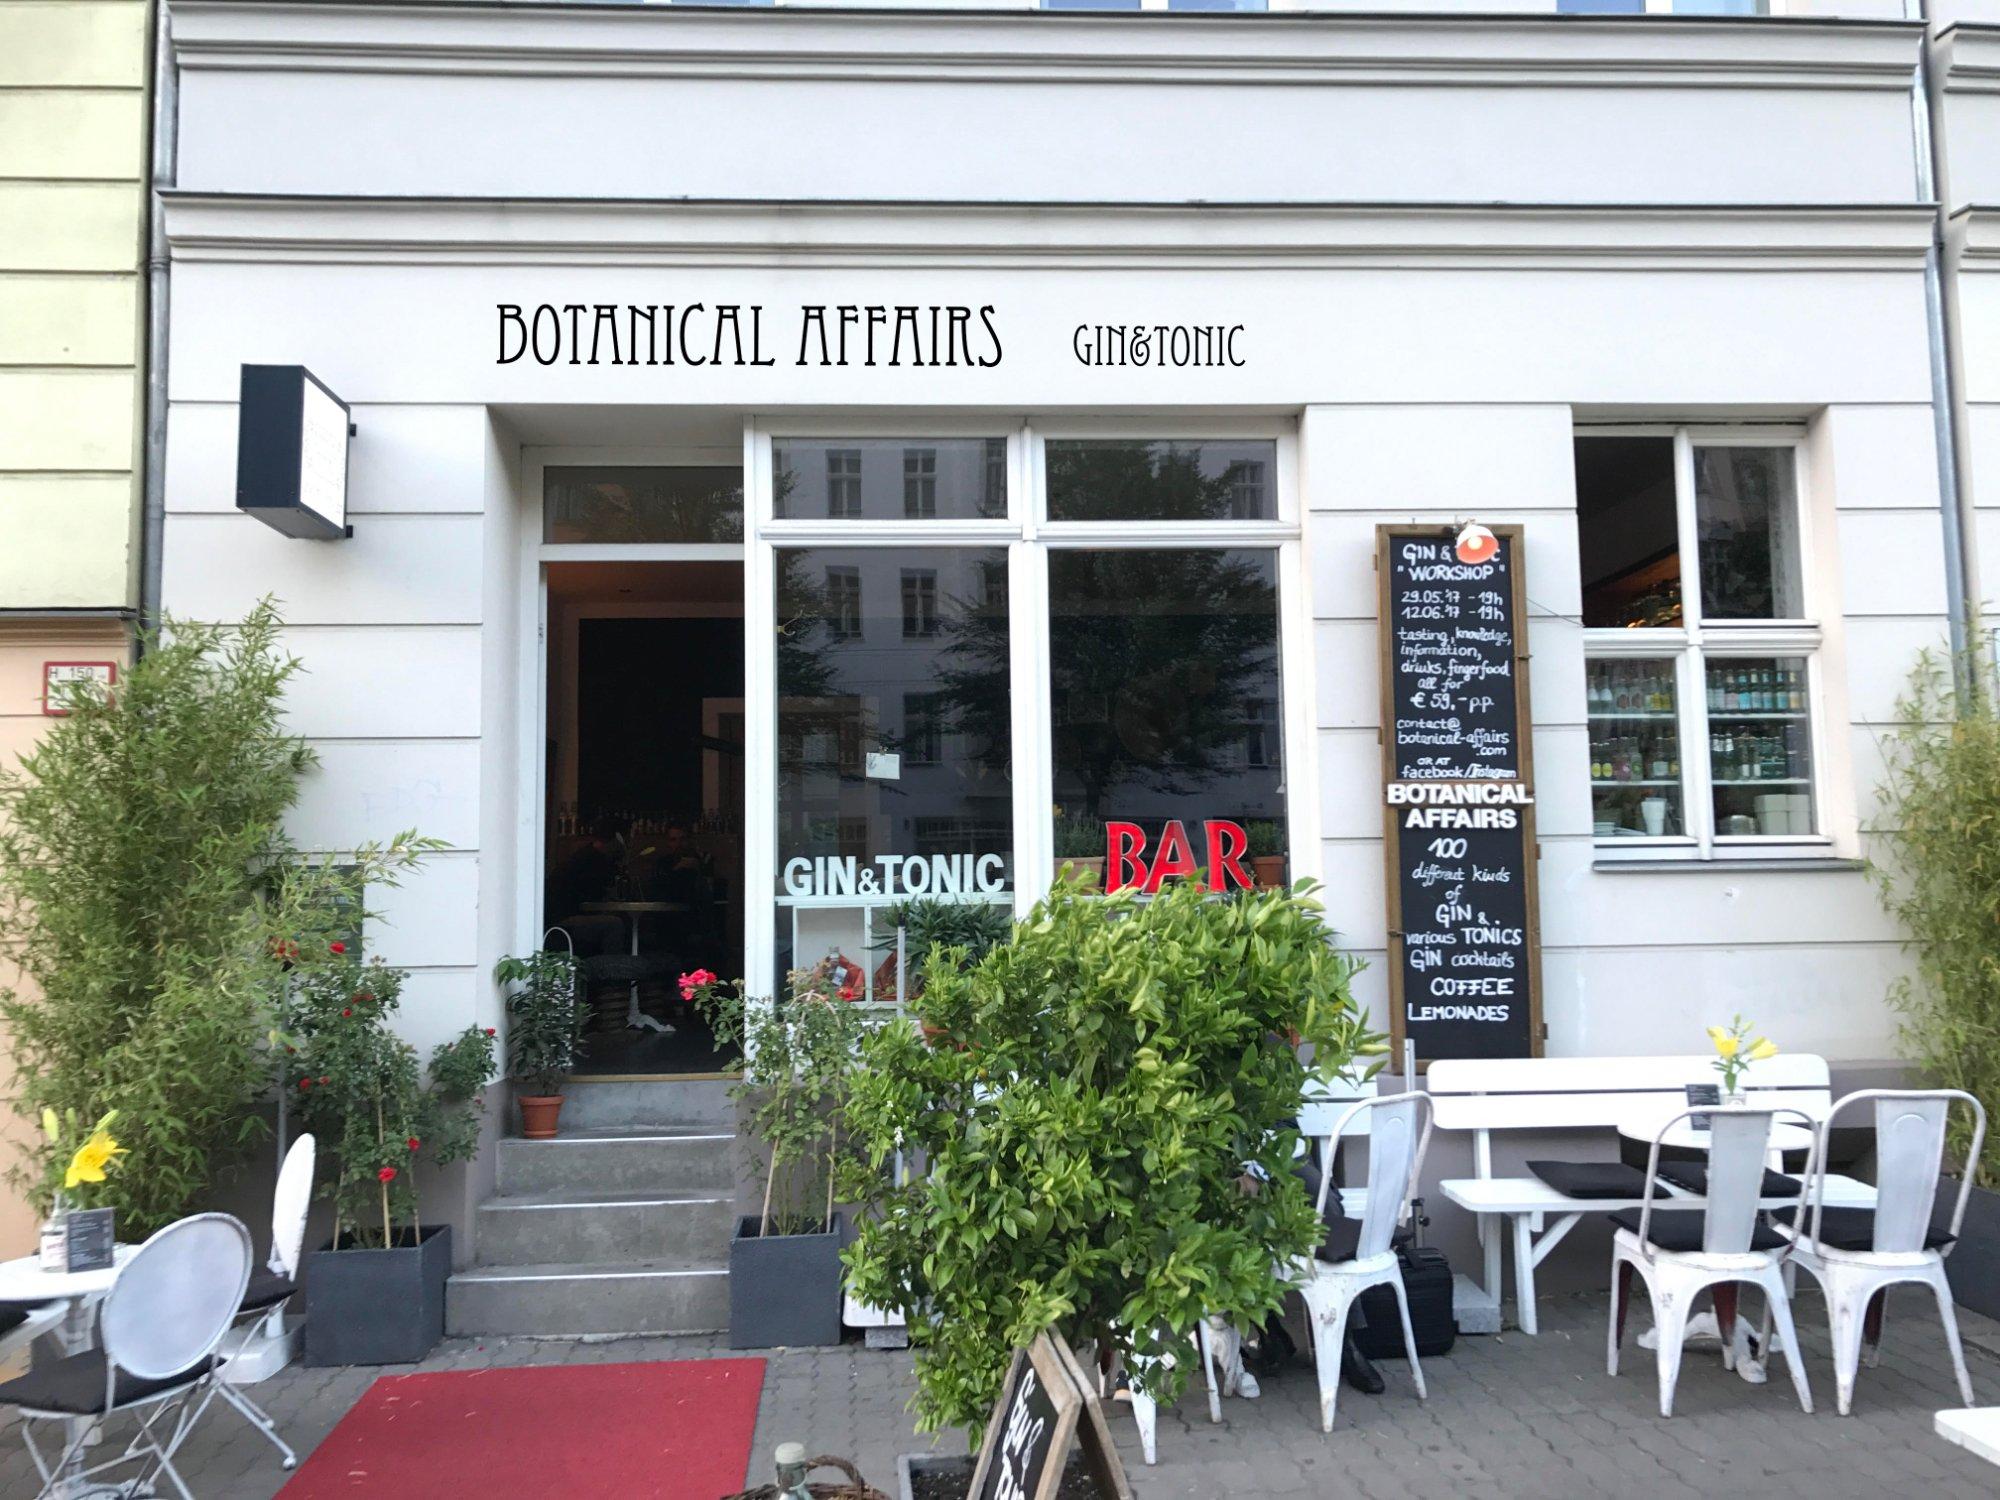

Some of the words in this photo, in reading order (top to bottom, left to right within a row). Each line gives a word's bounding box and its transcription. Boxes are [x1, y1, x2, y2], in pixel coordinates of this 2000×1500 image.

[496, 304, 775, 367] BOTANICAL
[796, 305, 1003, 367] AFFAIRS
[1072, 324, 1246, 368] GIN&TONIC
[1402, 543, 1436, 566] GIN
[1440, 546, 1453, 562] &
[1417, 677, 1437, 690] all
[1441, 678, 1464, 692] for
[1396, 717, 1461, 732] contact@
[1475, 746, 1507, 756] .com
[1387, 783, 1535, 804] BOTANICAL
[1404, 808, 1518, 829] AFFAIRS
[1105, 820, 1254, 895] BAR
[1427, 837, 1468, 859] 100
[783, 853, 1006, 897] GIN&TONIC
[1471, 864, 1511, 883] kinds
[1445, 884, 1464, 906] of
[1435, 904, 1472, 929] GIN
[1477, 911, 1491, 926] &
[1405, 931, 1457, 945] various
[1460, 920, 1523, 945] TONICS
[1409, 946, 1443, 973] GIN
[1430, 977, 1515, 996] COFFEE
[1407, 1003, 1510, 1022] LEMONADES
